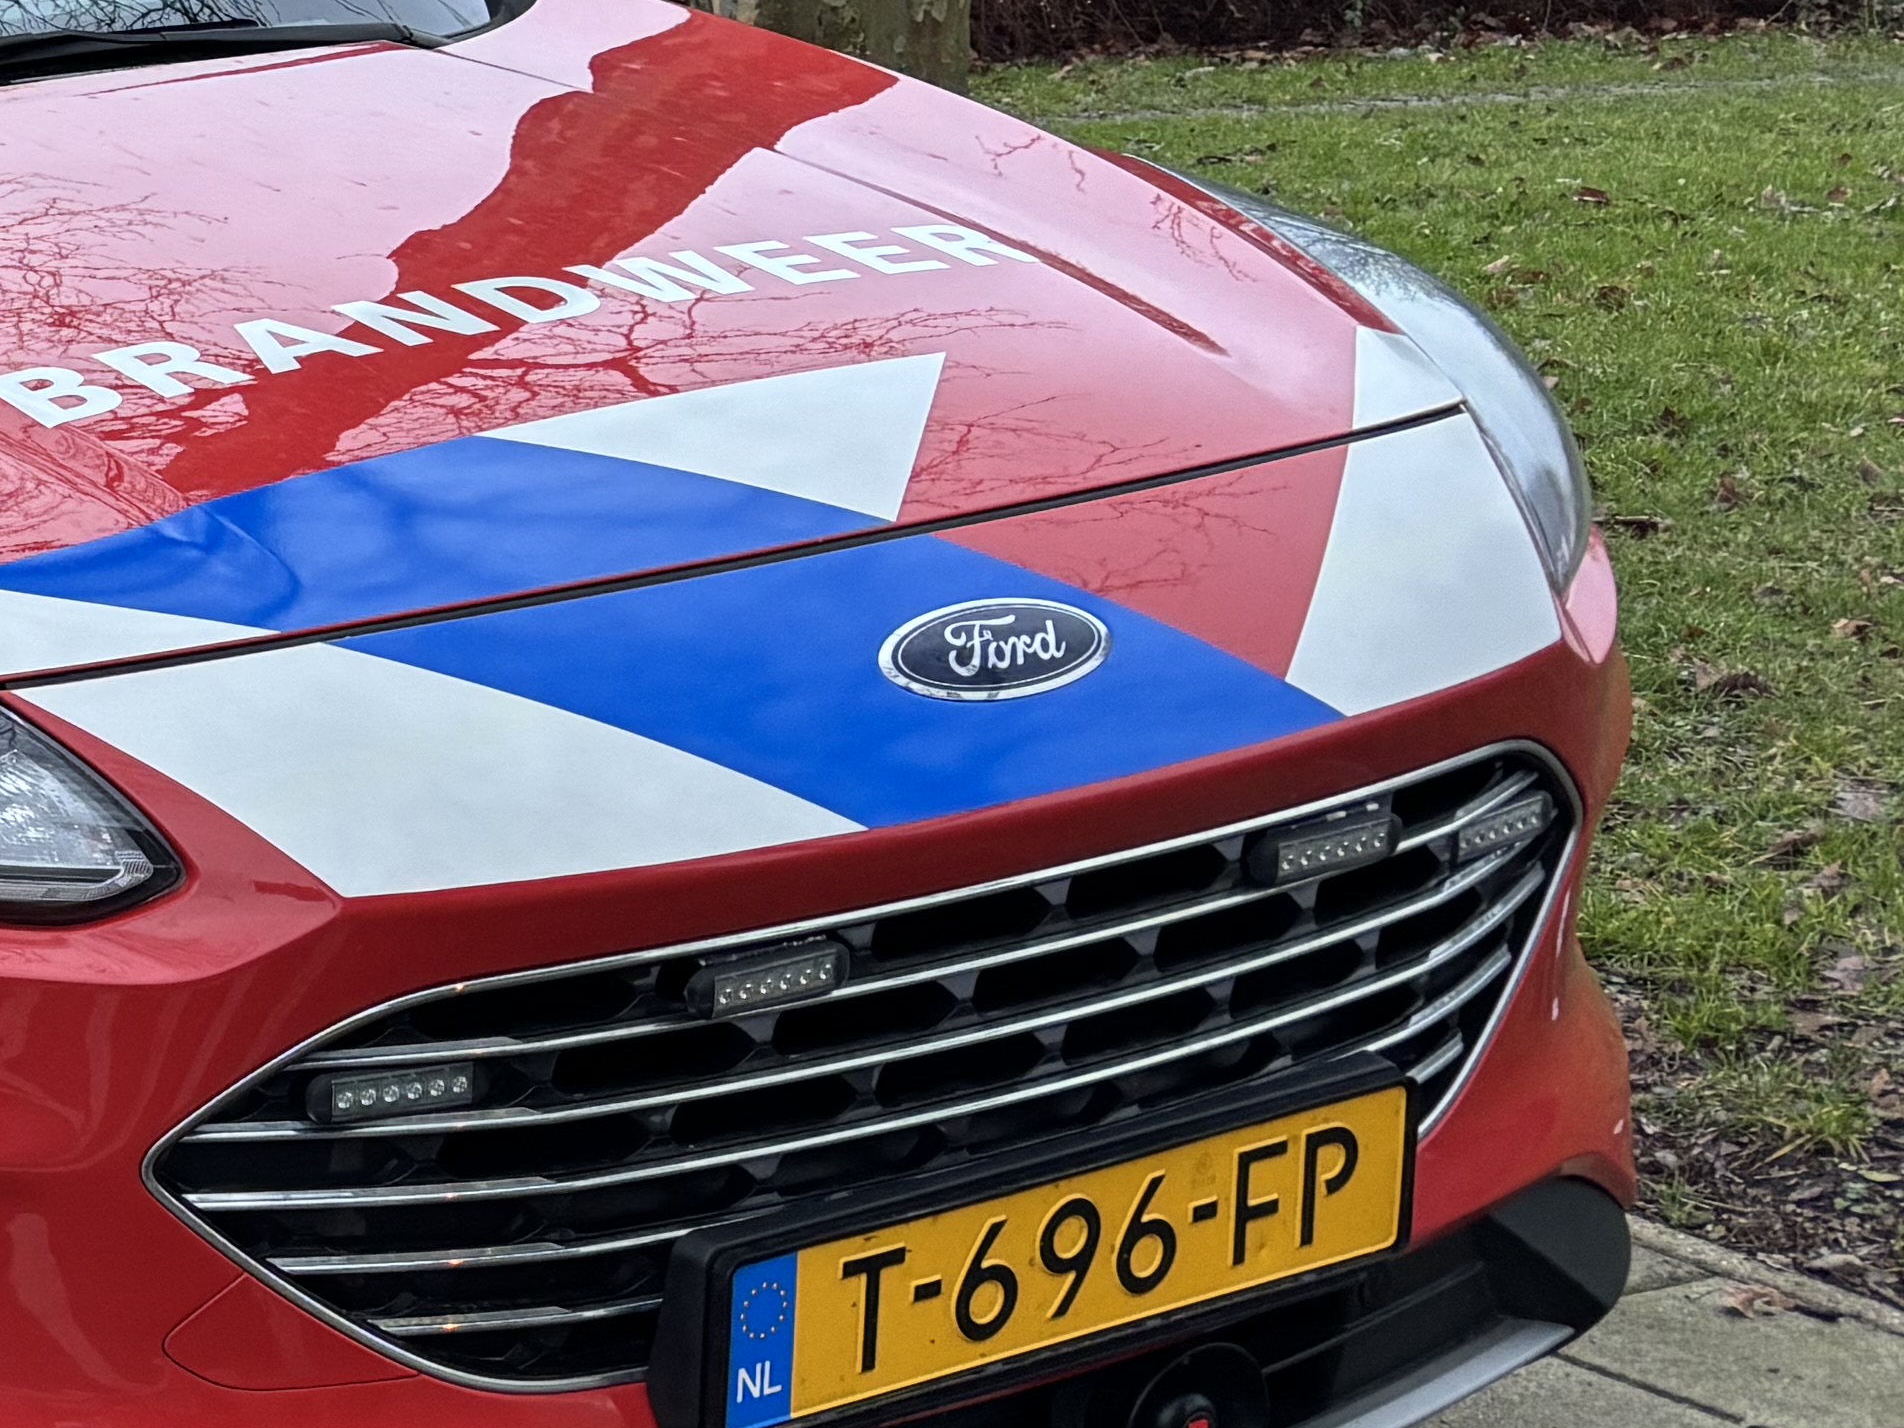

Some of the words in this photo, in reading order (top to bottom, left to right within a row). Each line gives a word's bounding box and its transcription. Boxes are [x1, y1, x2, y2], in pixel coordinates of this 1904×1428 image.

[943, 614, 1066, 677] Ford
[840, 1125, 1360, 1375] T-696-FP
[736, 1360, 783, 1404] NL
